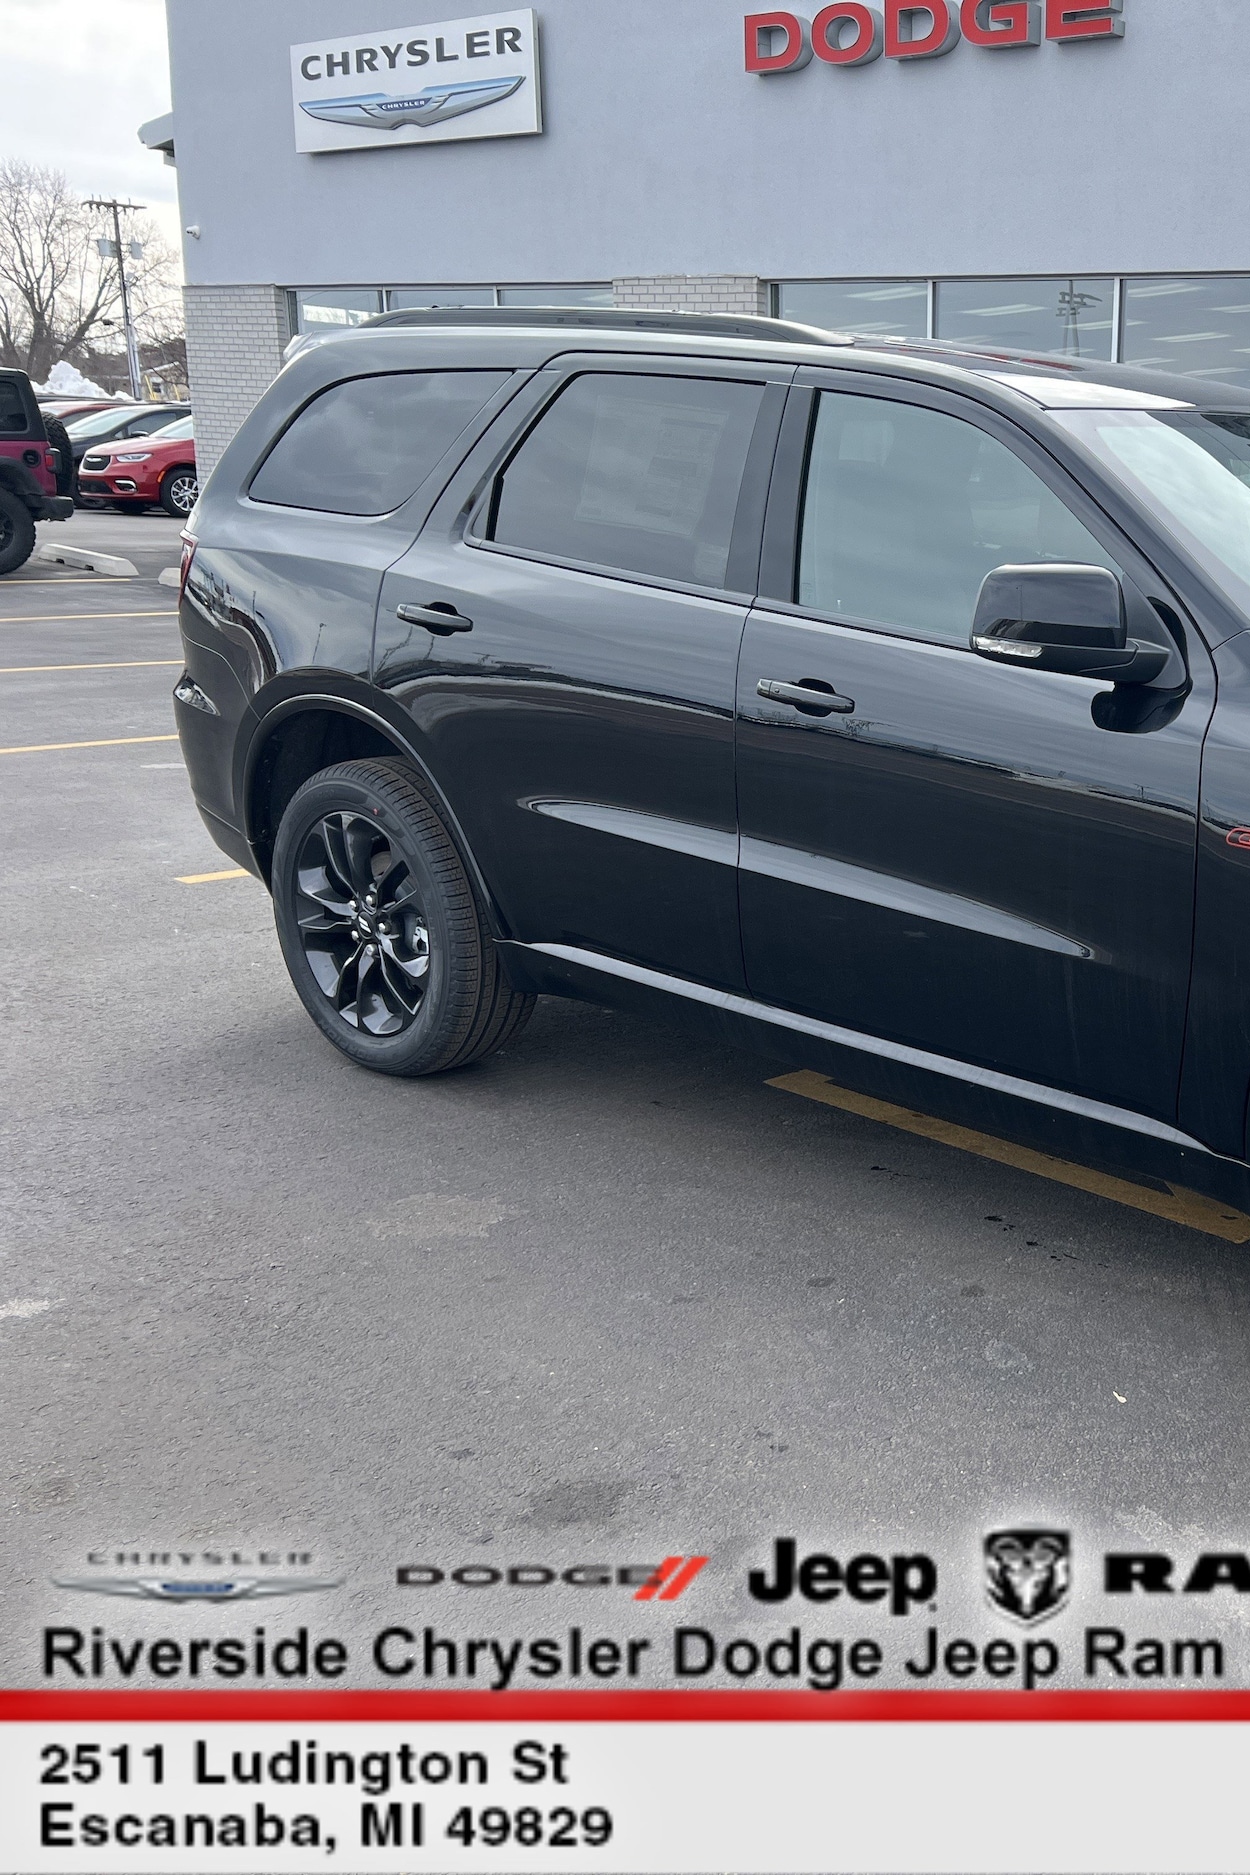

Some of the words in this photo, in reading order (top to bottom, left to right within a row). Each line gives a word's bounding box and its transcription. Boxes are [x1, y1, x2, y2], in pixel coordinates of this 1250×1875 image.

[301, 26, 523, 81] CHRYSLER
[744, 0, 1119, 73] DODGE
[382, 100, 425, 110] CHRYSLER
